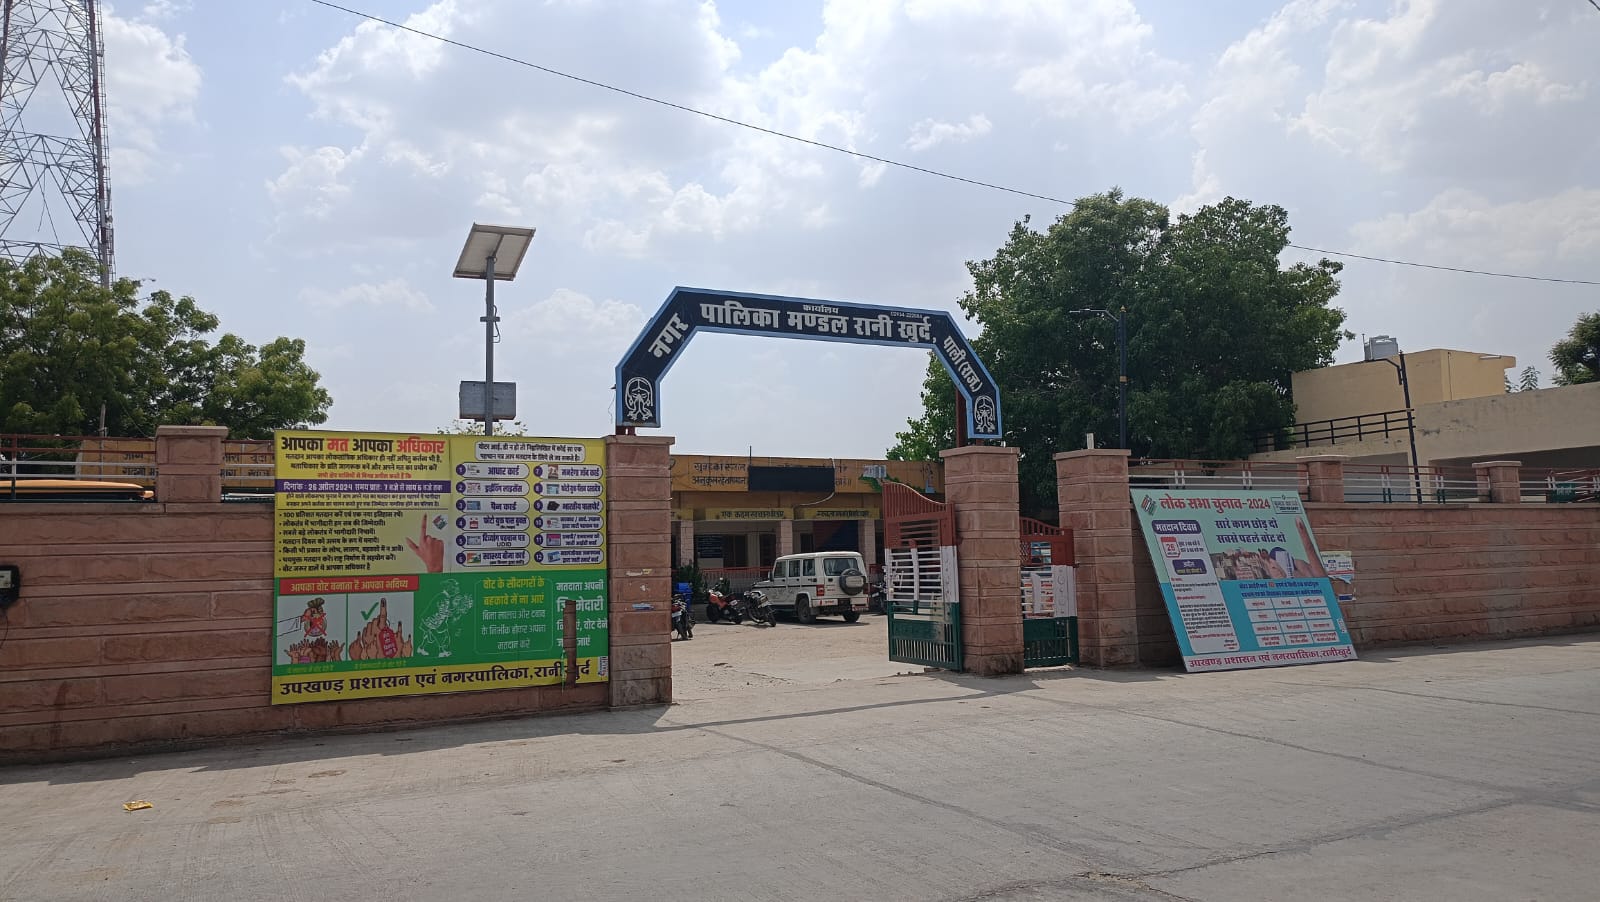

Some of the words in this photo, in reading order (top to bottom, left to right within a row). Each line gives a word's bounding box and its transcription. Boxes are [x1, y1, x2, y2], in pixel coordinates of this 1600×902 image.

[803, 304, 839, 314] कार्यालय
[648, 312, 689, 358] नगर
[699, 300, 781, 329] पालिका
[786, 311, 849, 334] मण्डल
[853, 314, 894, 337] रानी
[897, 316, 937, 344] खुर्द,
[943, 335, 967, 365] पाली
[958, 361, 983, 392] (राज.)
[281, 437, 324, 451] आपका
[326, 437, 349, 452] मत
[352, 438, 394, 452] आपका
[396, 436, 446, 454] अधिकार
[478, 443, 490, 451] वोटर
[488, 466, 506, 475] आधार
[507, 465, 520, 476] कार्ड
[561, 467, 578, 476] मनरेगा
[590, 467, 600, 477] कार्ड
[283, 482, 304, 490] दिनांक
[308, 483, 318, 491] 26
[335, 483, 352, 491] 2024
[503, 502, 517, 511] कार्ड
[562, 501, 581, 510] भारतीय
[1159, 493, 1186, 509] लोक
[1186, 498, 1211, 509] सभा
[1155, 523, 1179, 532] मतदान
[1179, 522, 1198, 532] दिवस
[1215, 517, 1231, 529] सारे
[1231, 519, 1250, 529] काम
[1251, 517, 1268, 531] छोड़
[1269, 517, 1279, 529] दो
[1216, 532, 1239, 544] सबसे
[1239, 532, 1260, 543] पहले
[1260, 531, 1276, 543] वोट
[1276, 531, 1287, 543] दो
[515, 551, 525, 559] कार्ड
[291, 583, 315, 592] आपका
[316, 580, 329, 591] वोट
[330, 582, 353, 591] बनाता
[354, 580, 359, 590] है
[361, 581, 384, 590] आपका
[386, 580, 408, 589] भविष्य
[483, 577, 496, 589] वोट
[497, 577, 504, 589] के
[538, 576, 545, 587] के
[555, 582, 583, 591] मतदाता
[584, 579, 604, 591] अपनी
[483, 594, 509, 605] बहकावे
[519, 595, 529, 604] ना
[482, 609, 497, 620] बिना
[498, 610, 517, 620] लालच
[518, 608, 530, 619] और
[481, 624, 488, 635] के
[512, 624, 528, 634] होकर
[529, 624, 546, 633] अपना
[584, 618, 596, 630] वोट
[497, 640, 518, 650] मतदान
[576, 635, 591, 647] जाएं
[1224, 654, 1257, 665] प्रशासन
[1259, 651, 1271, 663] एवं
[350, 675, 410, 691] प्रशासन
[415, 669, 437, 687] एवं
